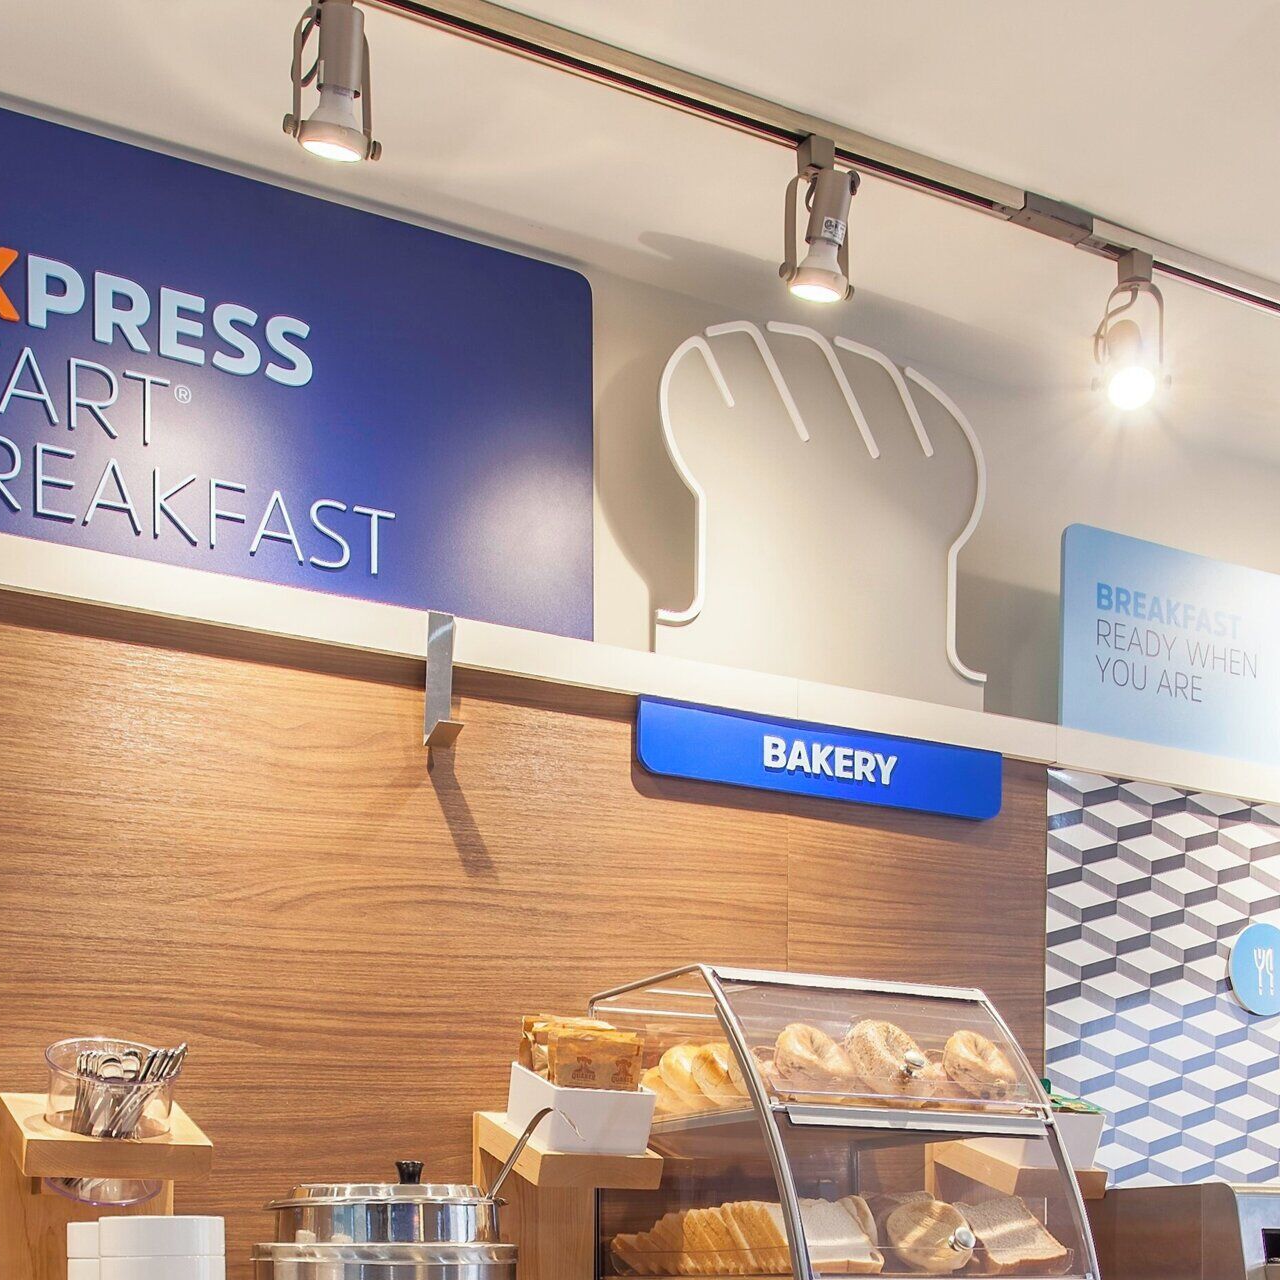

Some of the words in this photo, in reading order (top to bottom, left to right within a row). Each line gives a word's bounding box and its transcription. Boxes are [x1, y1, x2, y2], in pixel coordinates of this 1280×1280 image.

[1096, 582, 1242, 640] BREAKFAST
[1096, 619, 1177, 661] READY
[1186, 639, 1257, 679] WHEN
[1095, 654, 1147, 691] YOU
[1157, 669, 1202, 703] ARE
[763, 735, 898, 786] BAKERY
